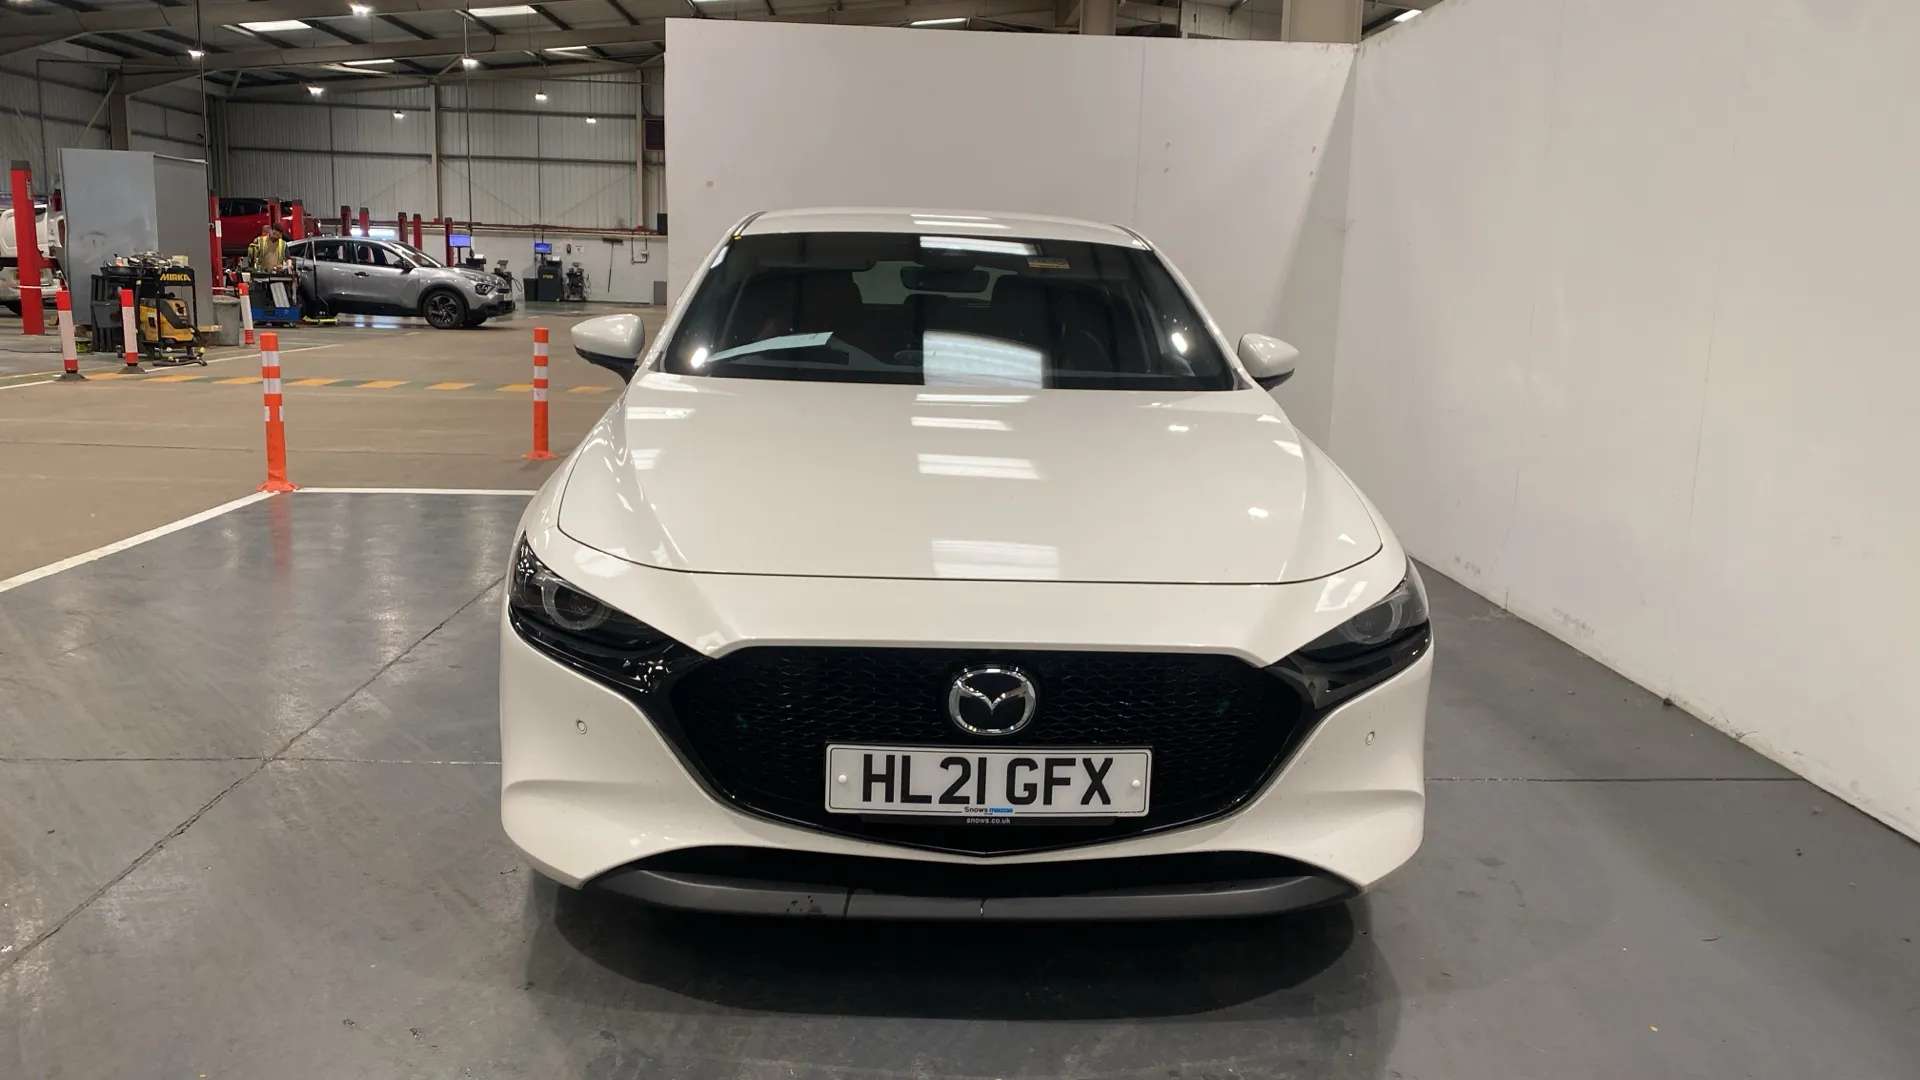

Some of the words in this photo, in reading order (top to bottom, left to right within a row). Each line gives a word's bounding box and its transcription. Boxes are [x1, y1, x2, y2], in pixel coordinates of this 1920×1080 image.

[160, 273, 191, 281] MIRKA
[863, 754, 988, 805] HL21
[1006, 757, 1114, 806] GFX
